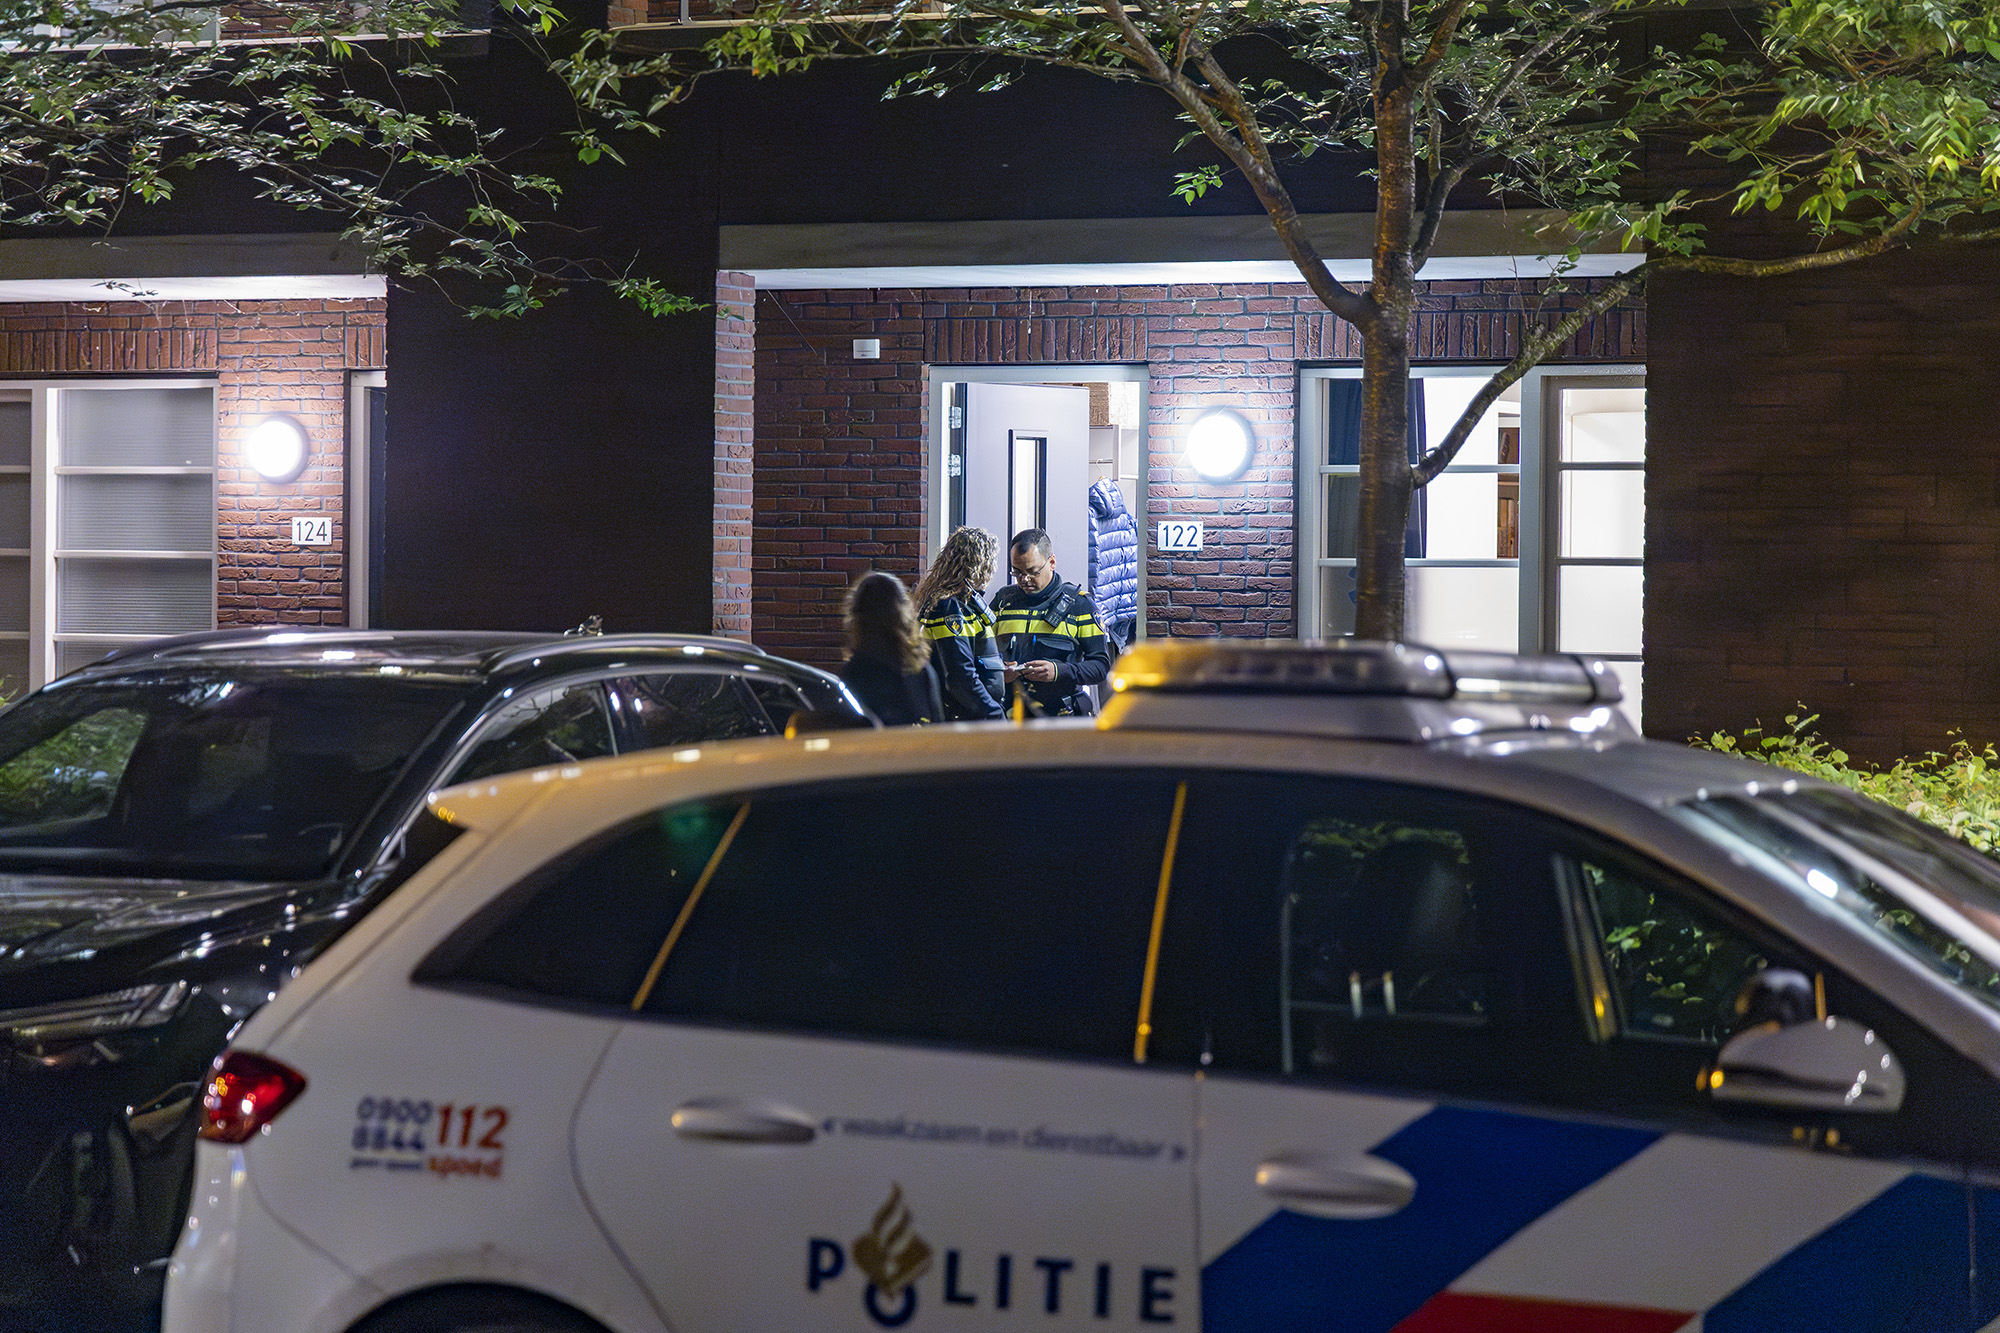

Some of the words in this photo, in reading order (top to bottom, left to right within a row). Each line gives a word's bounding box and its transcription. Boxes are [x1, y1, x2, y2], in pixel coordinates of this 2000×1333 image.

[296, 520, 328, 542] 124
[1163, 524, 1198, 547] 122
[356, 1096, 433, 1125] 0900
[437, 1103, 508, 1150] 112
[807, 1236, 1176, 1329] POLITIE
